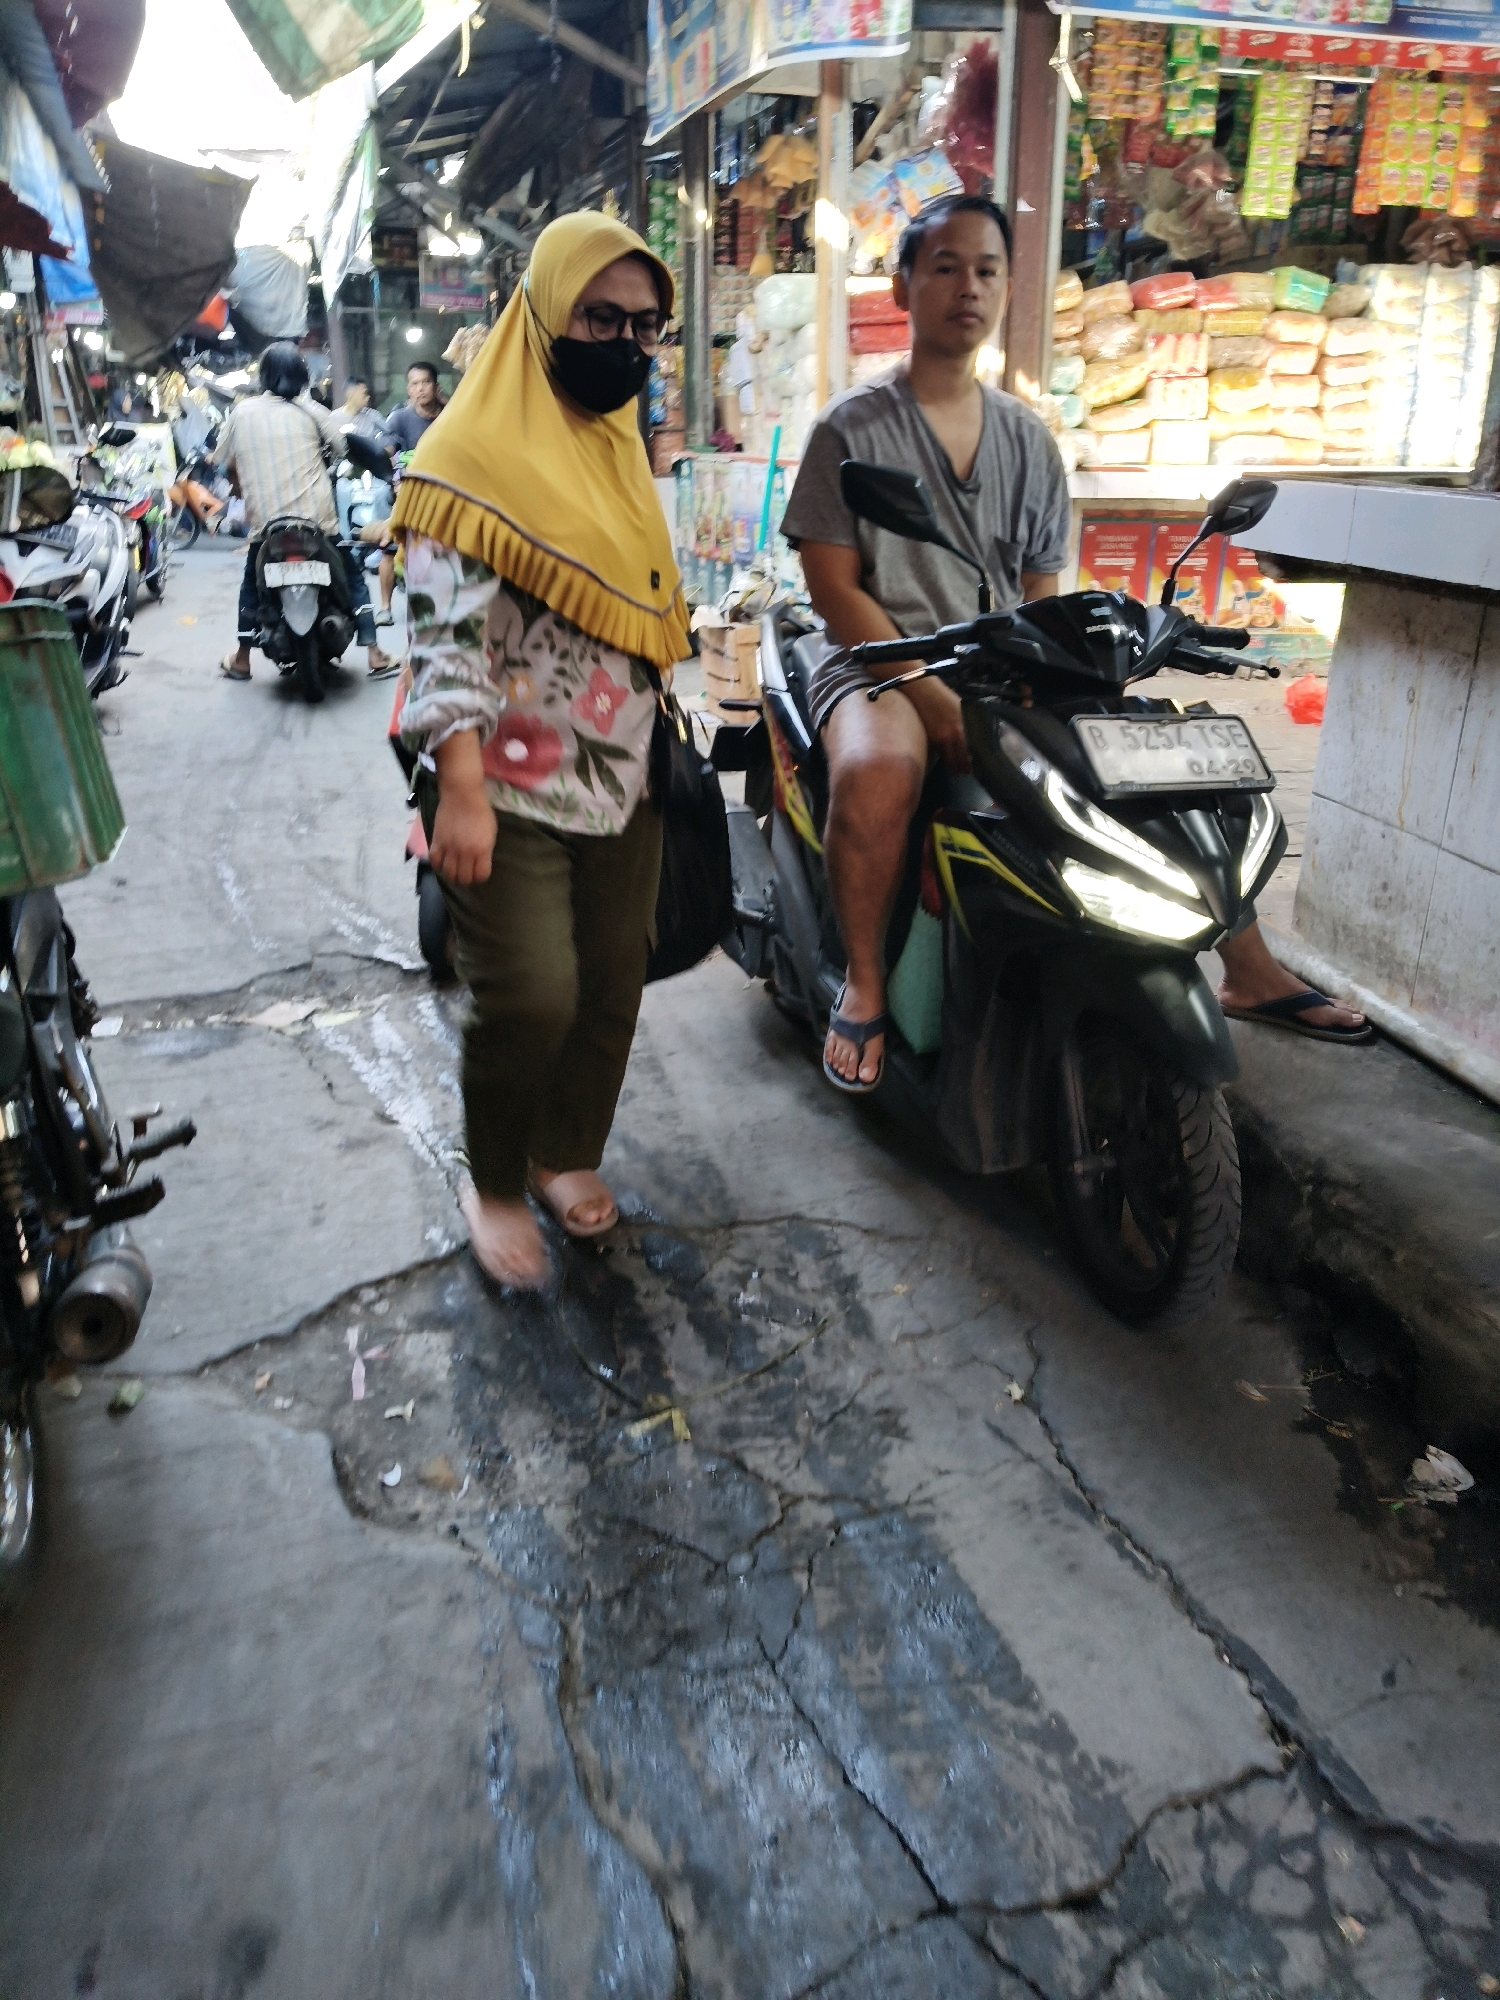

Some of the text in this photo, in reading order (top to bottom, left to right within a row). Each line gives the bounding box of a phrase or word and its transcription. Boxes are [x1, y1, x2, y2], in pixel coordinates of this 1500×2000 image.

[1088, 724, 1249, 750] B 5254 TSE
